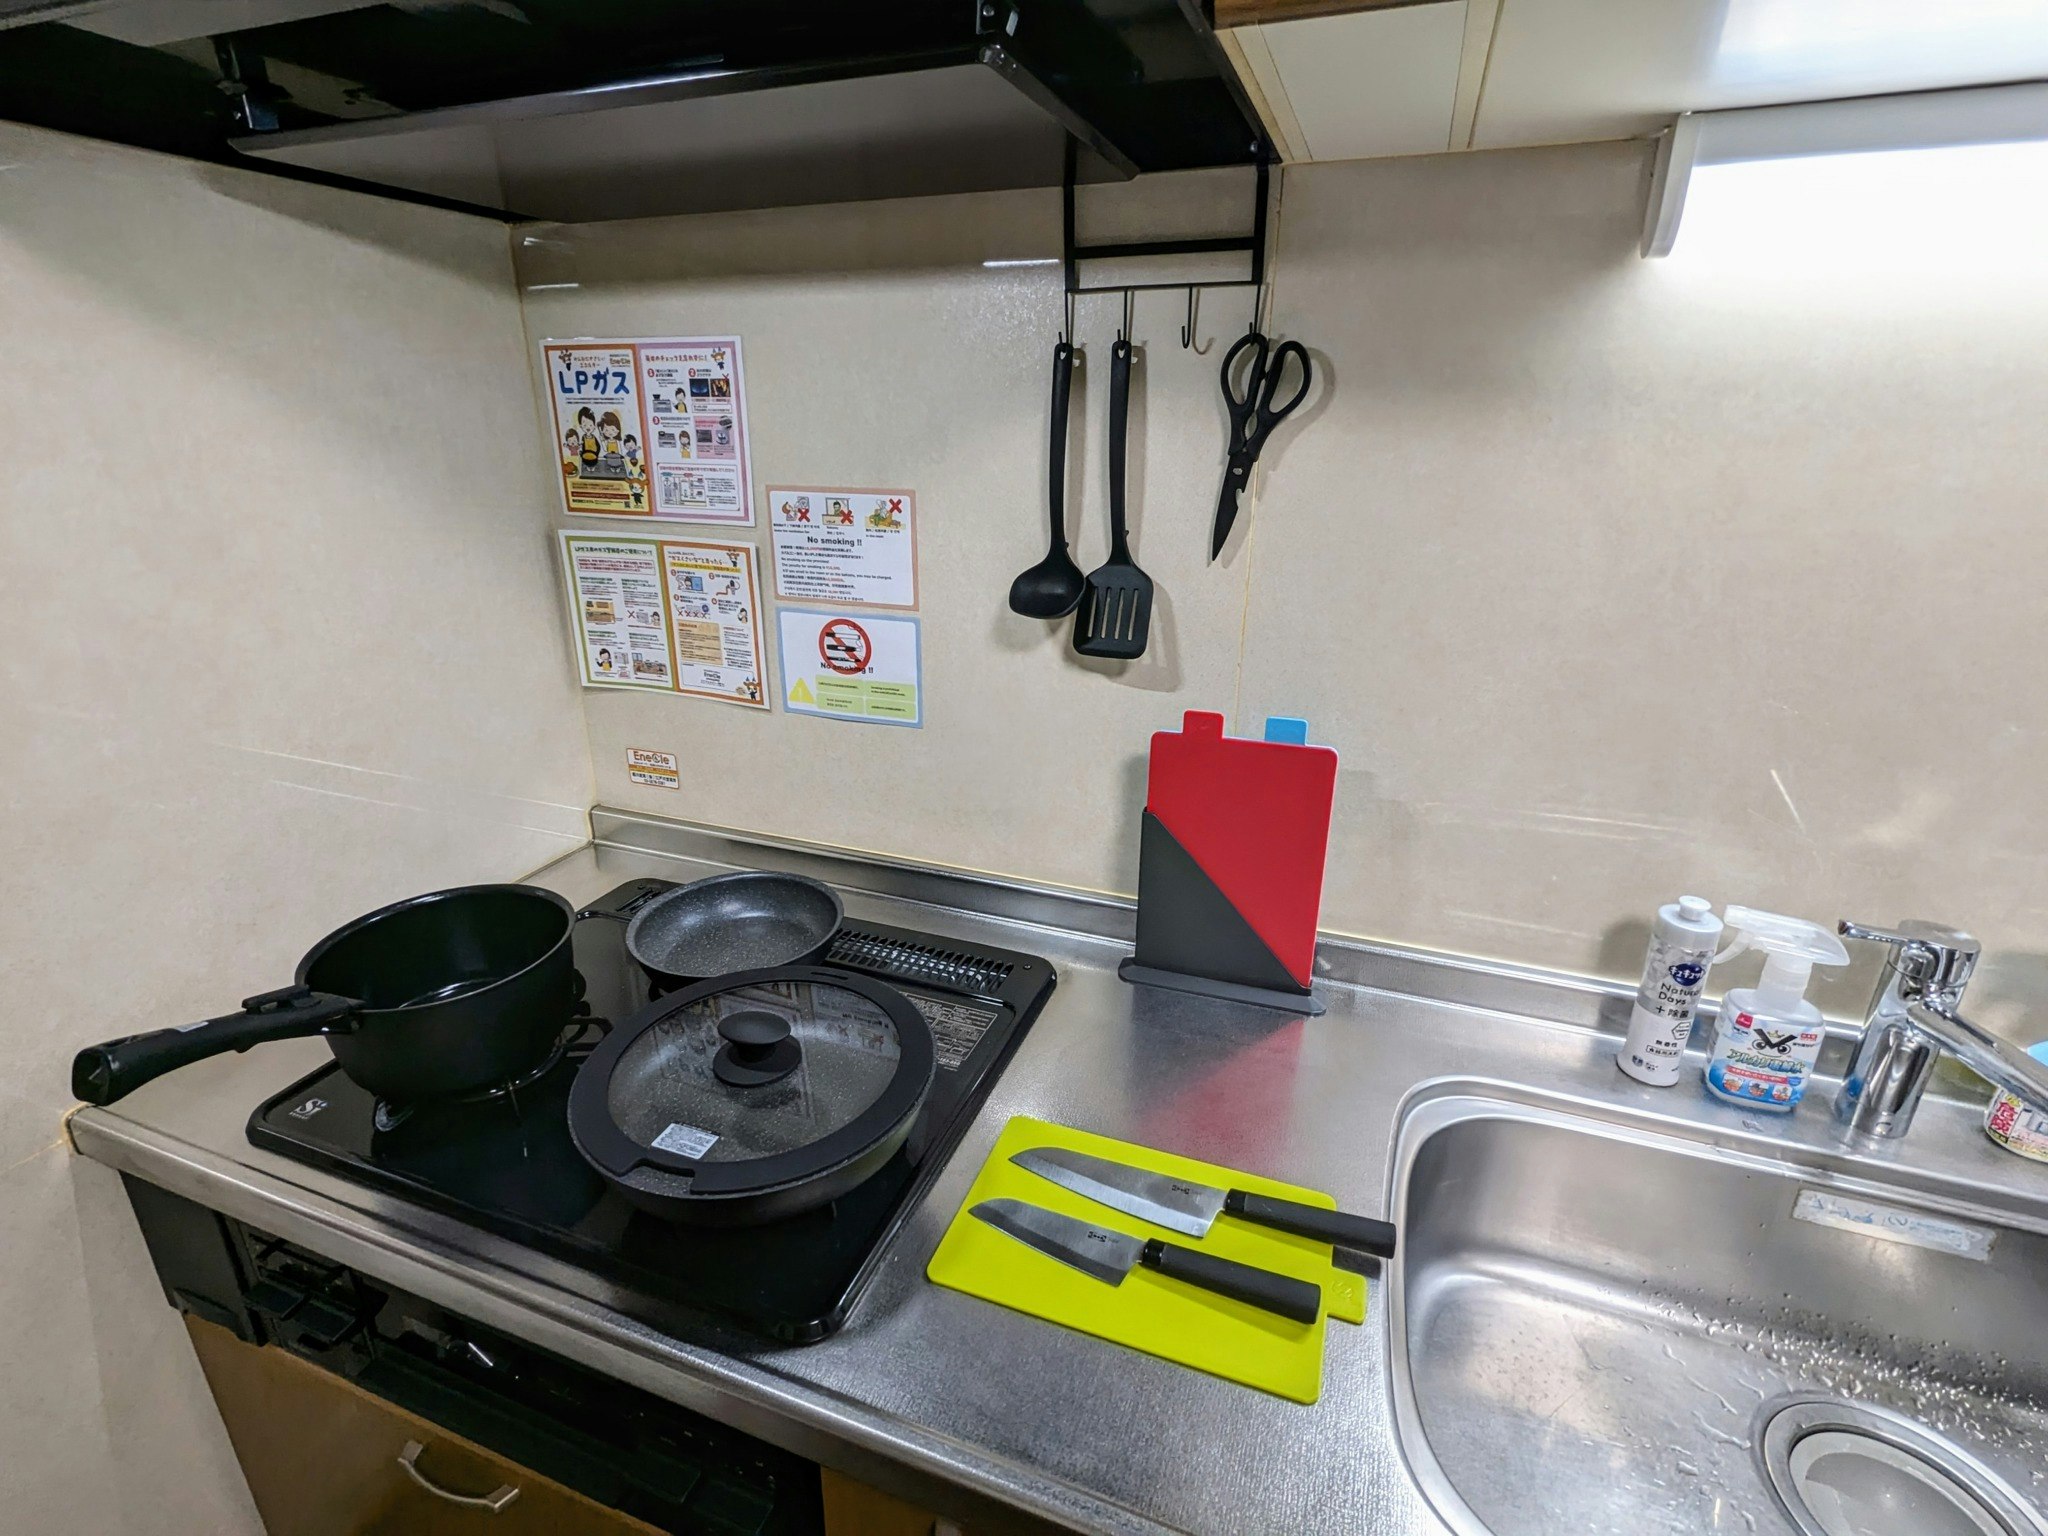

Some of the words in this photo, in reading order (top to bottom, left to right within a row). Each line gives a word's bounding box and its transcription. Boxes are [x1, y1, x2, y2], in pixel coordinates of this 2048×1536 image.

[559, 367, 630, 395] LPガス
[820, 537, 855, 547] smoking
[857, 538, 862, 546] !!
[1658, 991, 1687, 1005] Days
